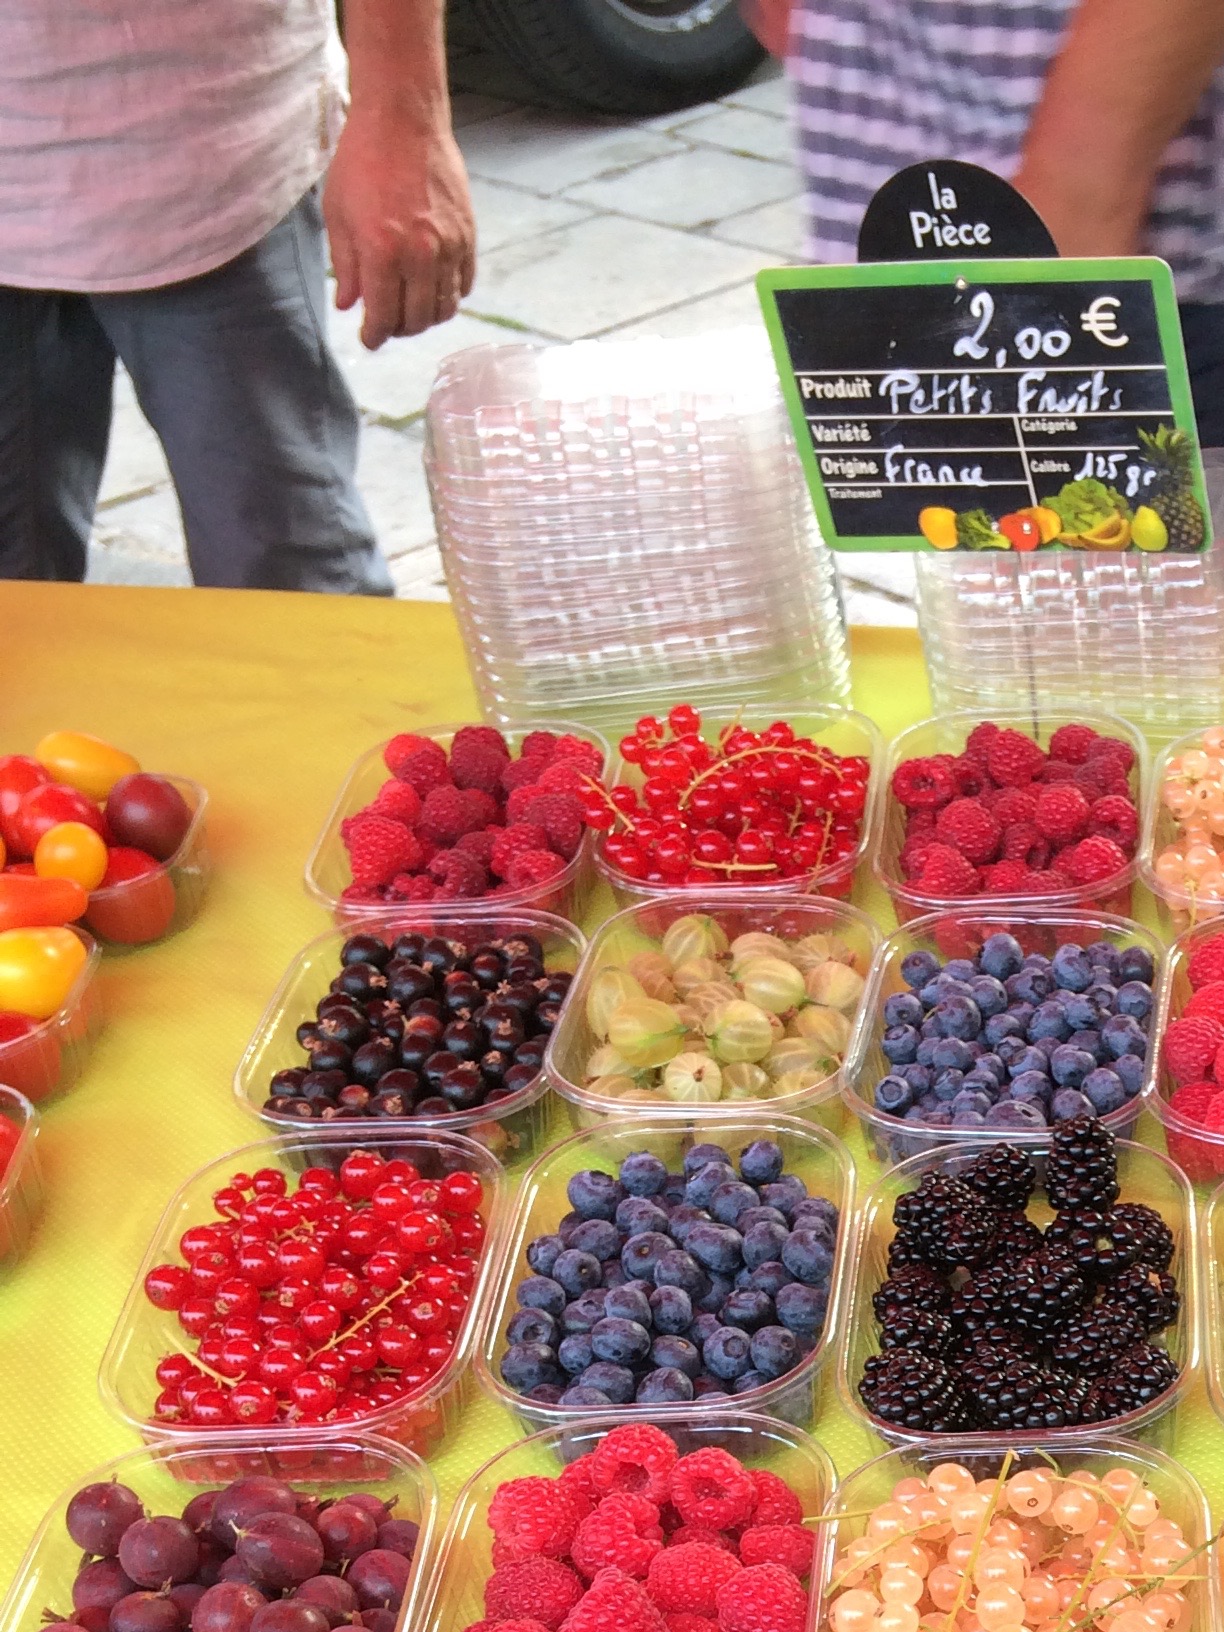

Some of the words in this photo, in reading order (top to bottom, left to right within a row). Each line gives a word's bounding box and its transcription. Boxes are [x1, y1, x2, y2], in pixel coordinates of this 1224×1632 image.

[928, 172, 957, 211] la
[910, 211, 991, 249] Pièce
[953, 291, 1071, 369] 2,00
[1080, 296, 1129, 347] €
[801, 378, 873, 399] Produit
[878, 370, 993, 415] Petits
[1017, 370, 1123, 414] Fruits
[812, 422, 873, 442] Variété
[1021, 418, 1078, 435] Catégorie
[821, 456, 880, 479] Origine
[884, 444, 989, 487] France
[1030, 460, 1072, 473] Calibre
[827, 487, 883, 499] Traitement
